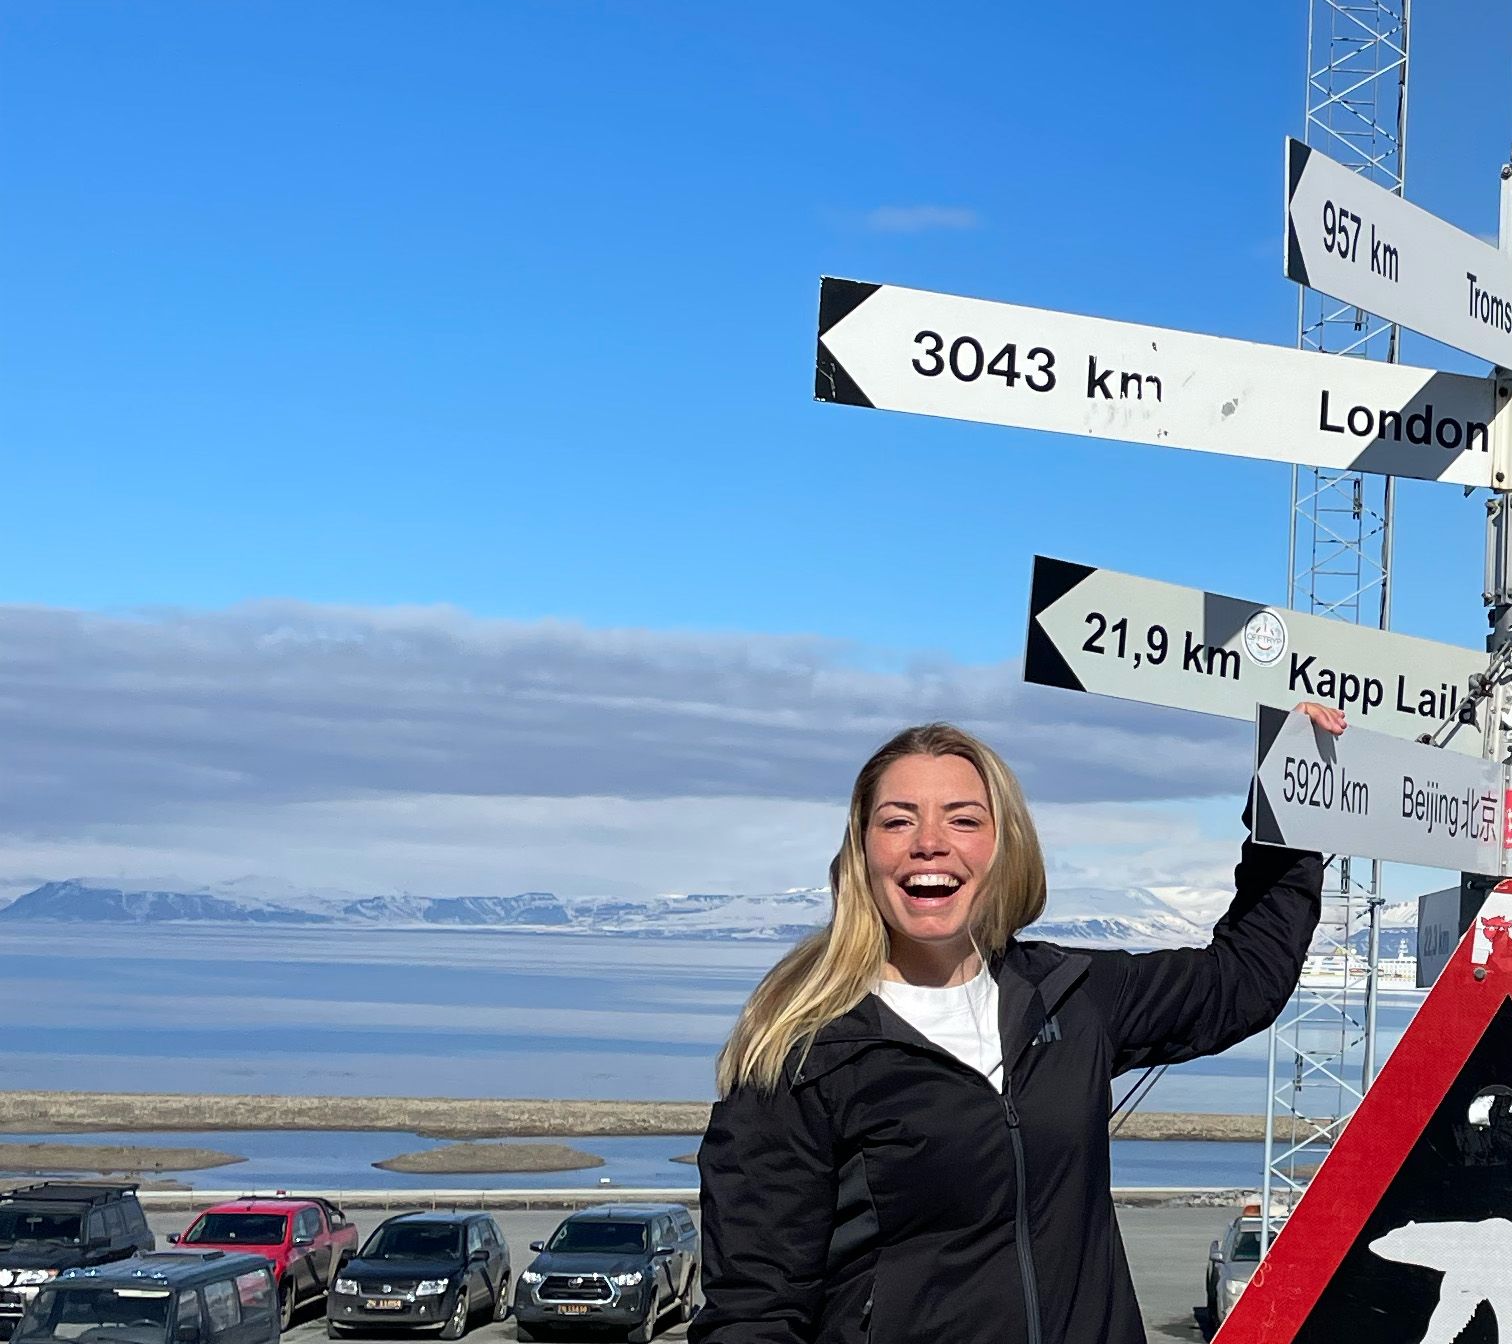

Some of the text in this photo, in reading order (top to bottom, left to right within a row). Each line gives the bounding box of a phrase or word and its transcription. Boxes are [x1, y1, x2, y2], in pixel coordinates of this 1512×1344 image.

[1322, 199, 1363, 264] 957
[1369, 223, 1401, 284] km
[911, 328, 1491, 454] 3043 km London
[1082, 610, 1478, 727] 21,9 km Kapp Laila
[1282, 755, 1459, 831] 5920 km Beijing
